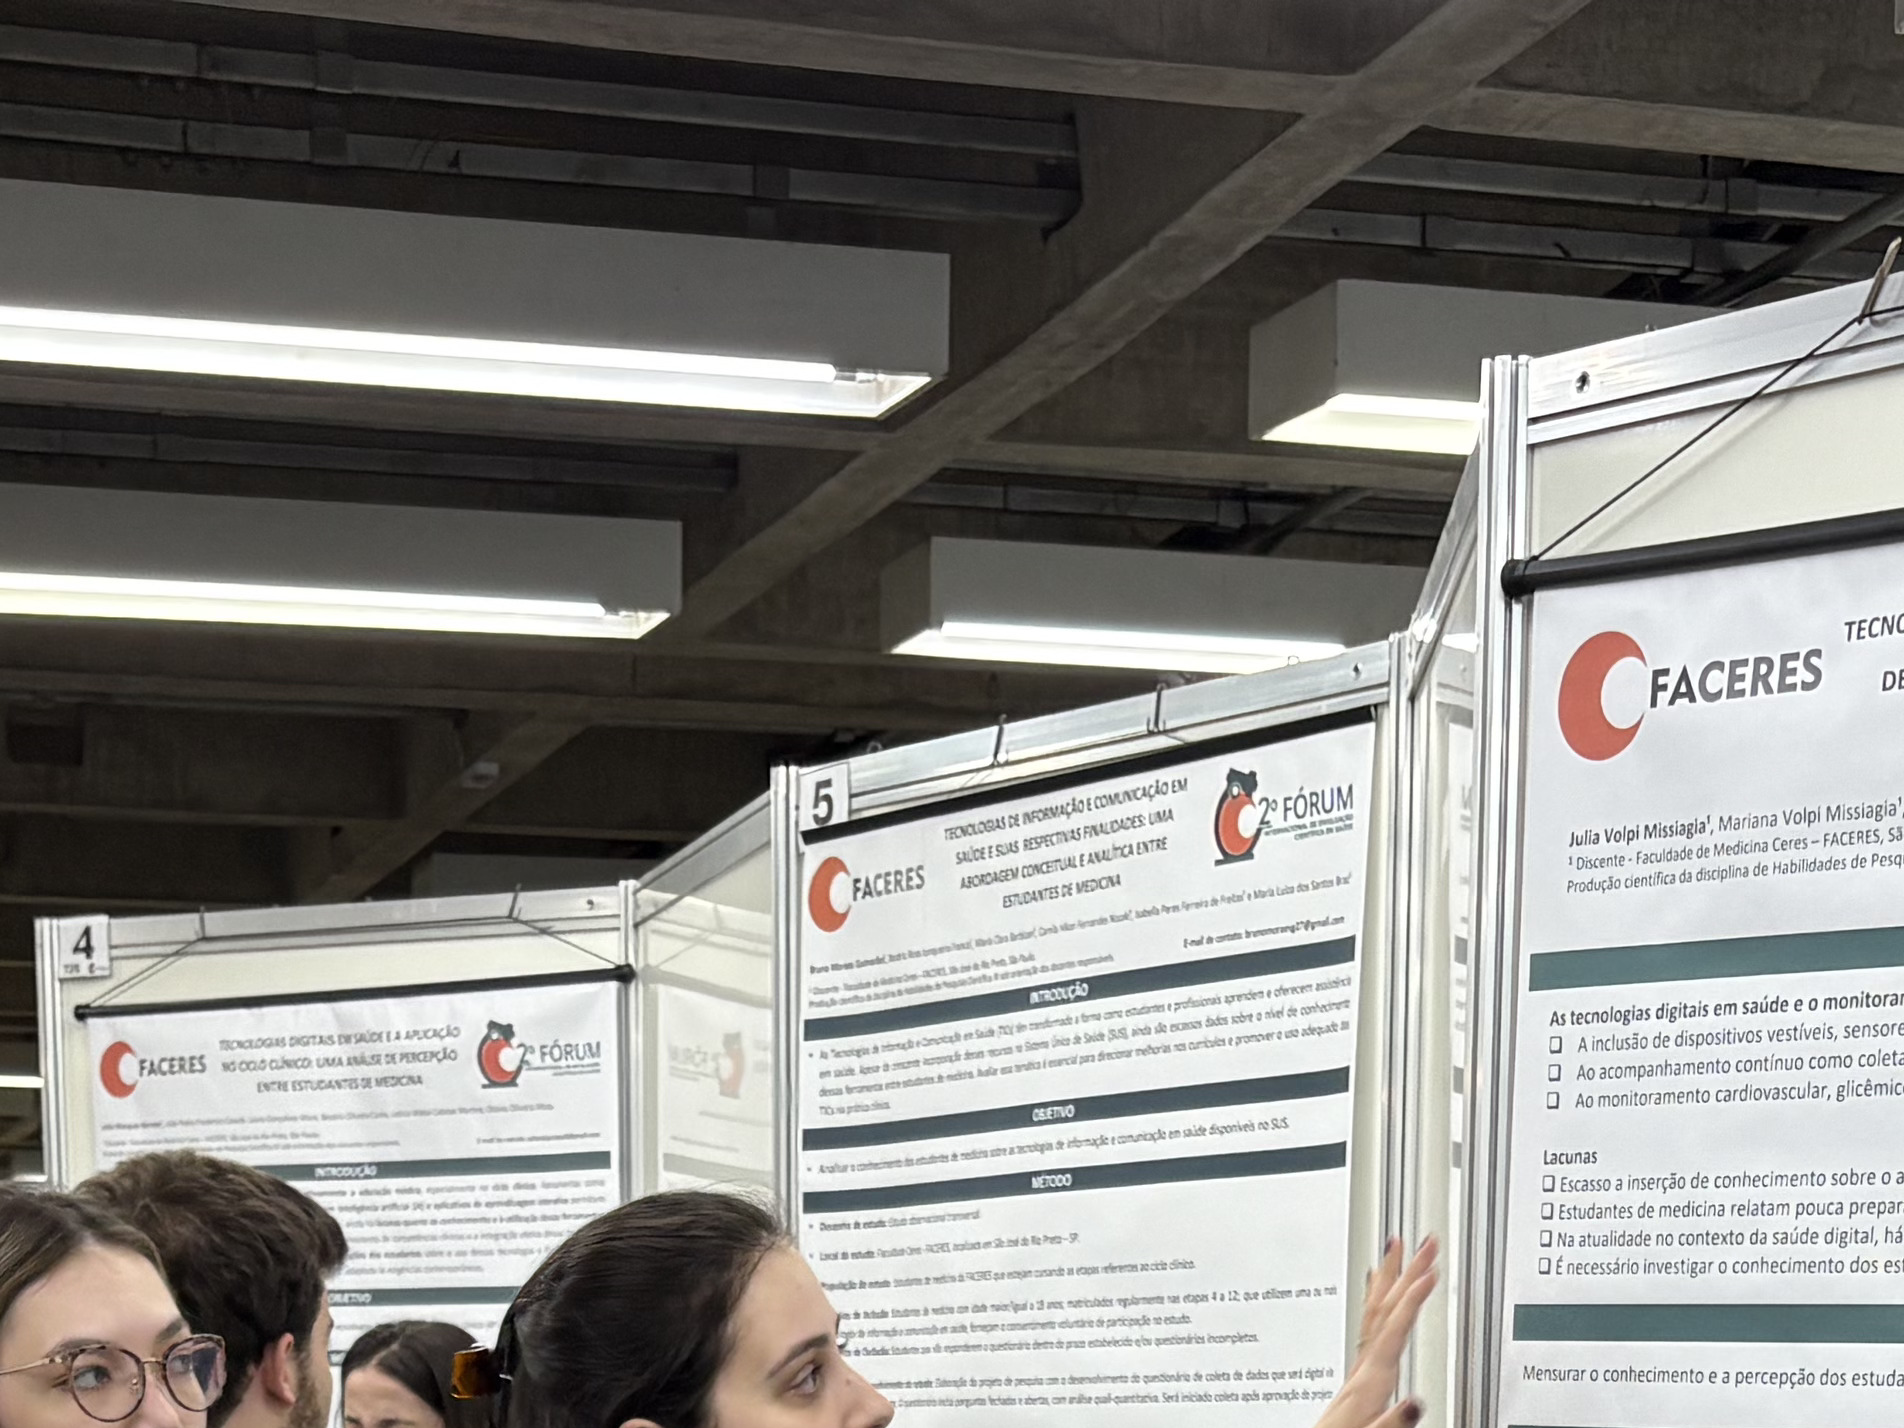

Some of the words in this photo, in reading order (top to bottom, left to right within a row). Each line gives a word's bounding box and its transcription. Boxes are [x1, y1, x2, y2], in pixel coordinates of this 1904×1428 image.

[1650, 648, 1823, 709] FACERES
[812, 778, 833, 826] 5
[1283, 784, 1354, 822] FÓRUM
[852, 864, 926, 902] FACERES
[72, 925, 94, 960] 4
[139, 1054, 207, 1078] FACERES
[539, 1039, 601, 1063] FÓRUM
